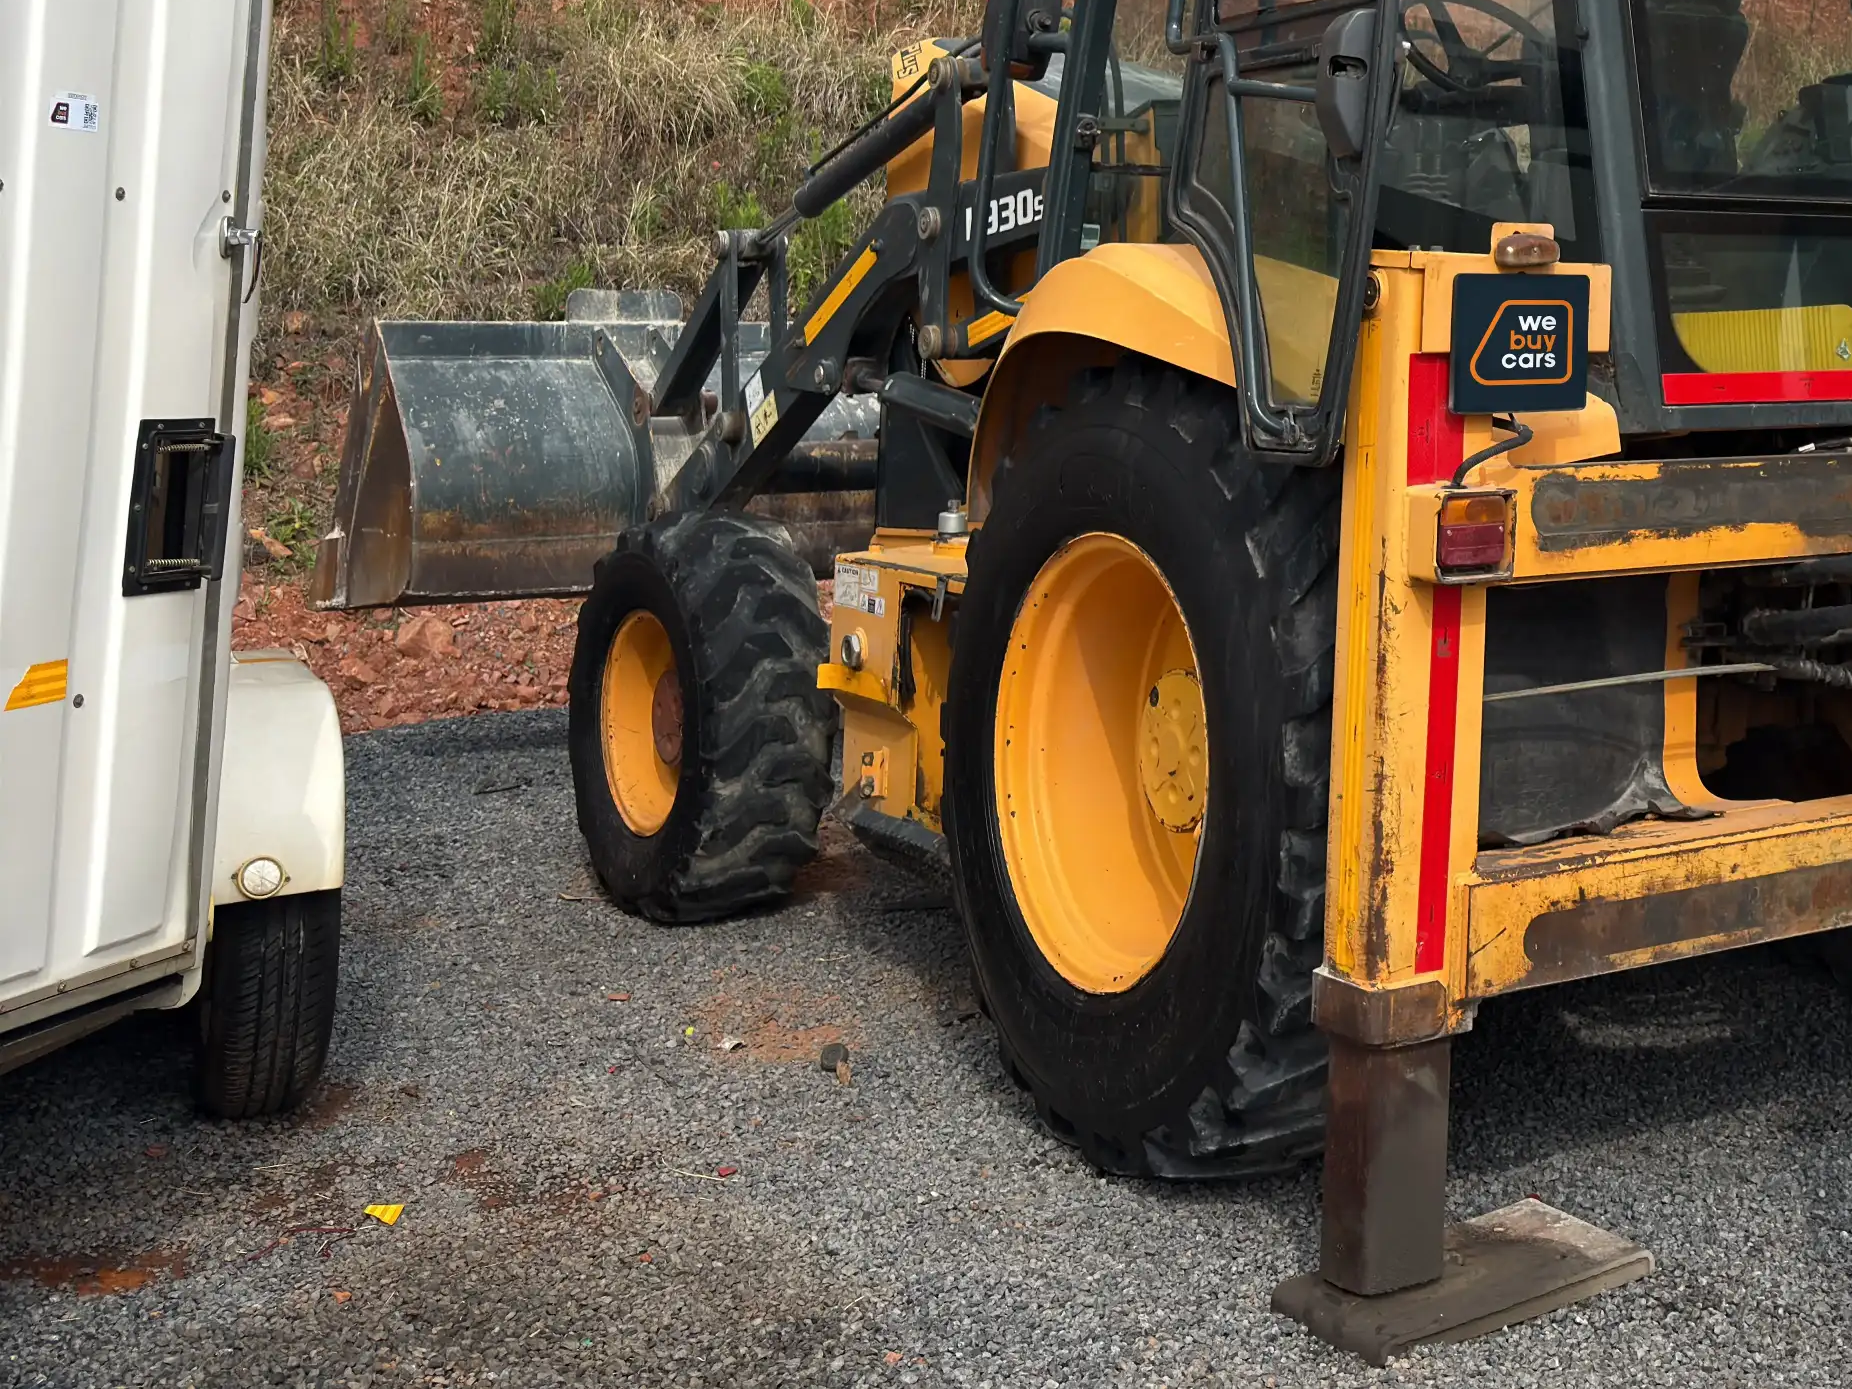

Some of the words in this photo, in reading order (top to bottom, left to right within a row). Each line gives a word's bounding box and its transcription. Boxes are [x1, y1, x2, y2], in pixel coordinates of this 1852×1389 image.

[1518, 315, 1557, 331] we
[1510, 330, 1556, 352] buy
[1501, 352, 1556, 369] cars
[842, 567, 859, 576] CAUTION
